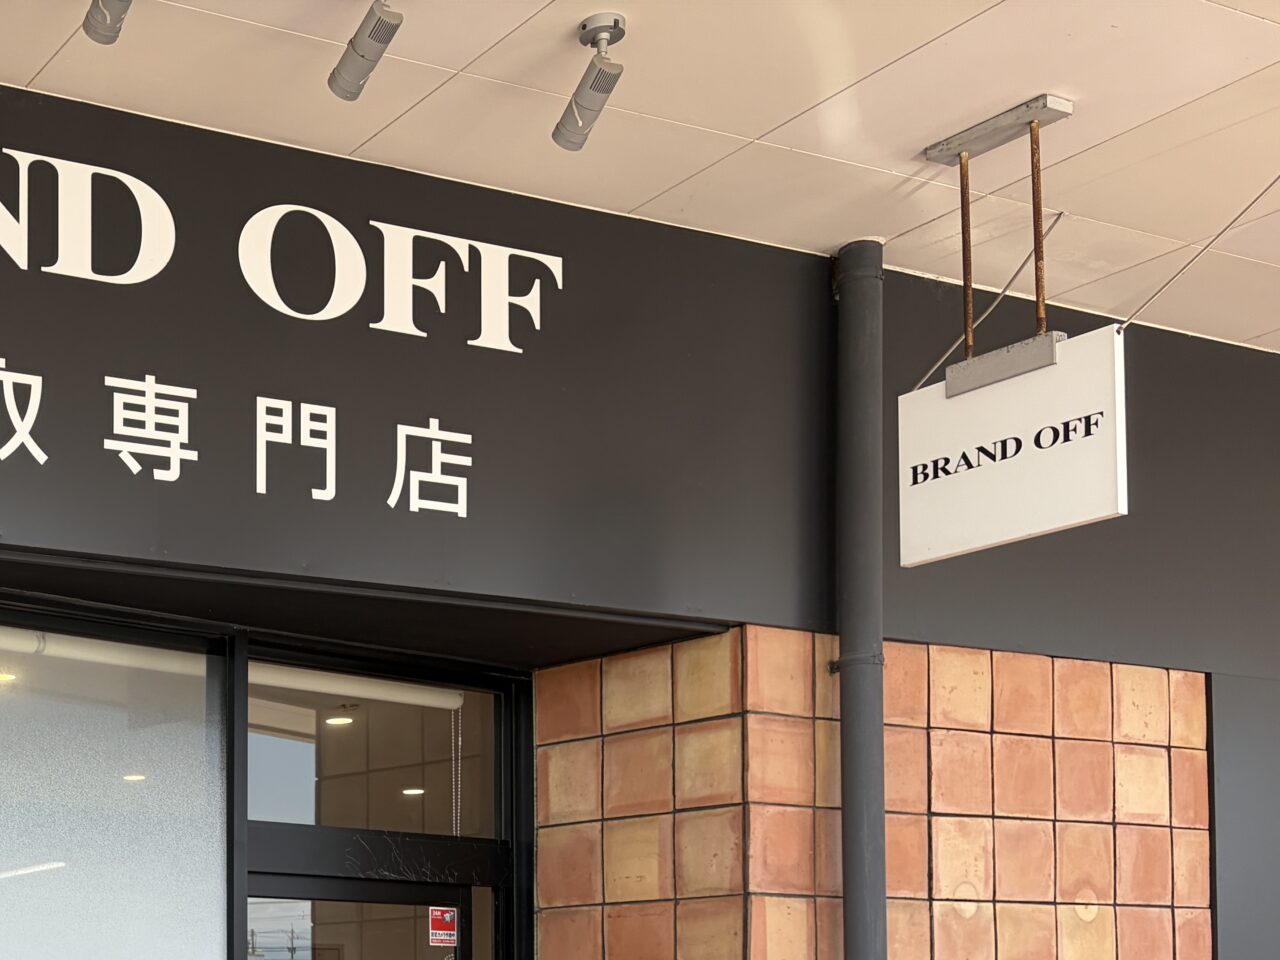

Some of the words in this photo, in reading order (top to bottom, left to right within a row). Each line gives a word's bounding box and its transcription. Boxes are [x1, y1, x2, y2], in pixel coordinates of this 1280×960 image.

[238, 204, 563, 353] OFF
[909, 436, 1023, 487] BRAND
[1033, 411, 1105, 449] OFF
